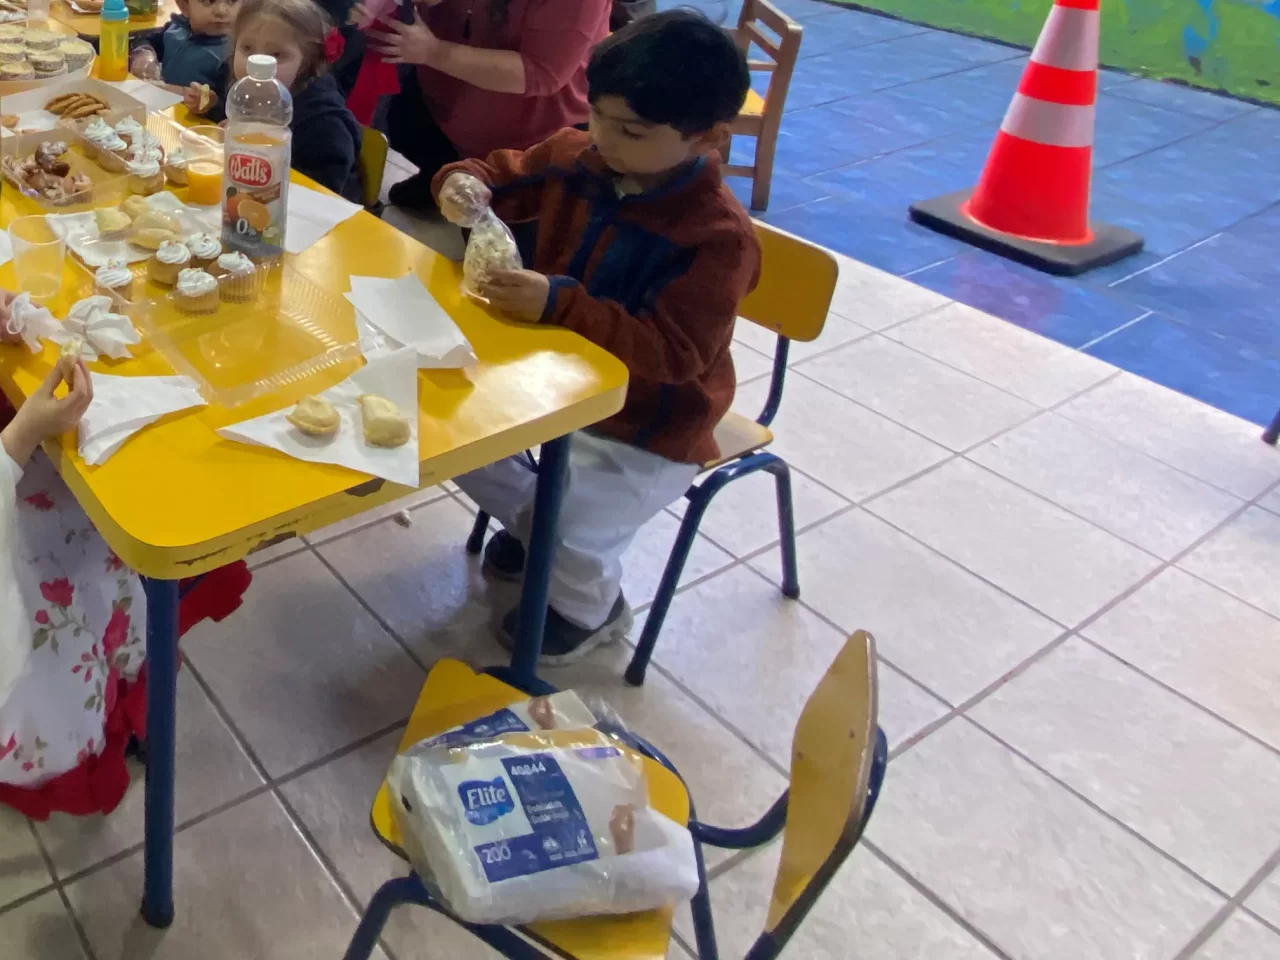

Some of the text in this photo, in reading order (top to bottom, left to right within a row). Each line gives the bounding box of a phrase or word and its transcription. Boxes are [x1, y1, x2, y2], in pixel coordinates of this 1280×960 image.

[230, 156, 268, 183] Watt's
[466, 785, 507, 810] Elite
[481, 844, 512, 864] 200
